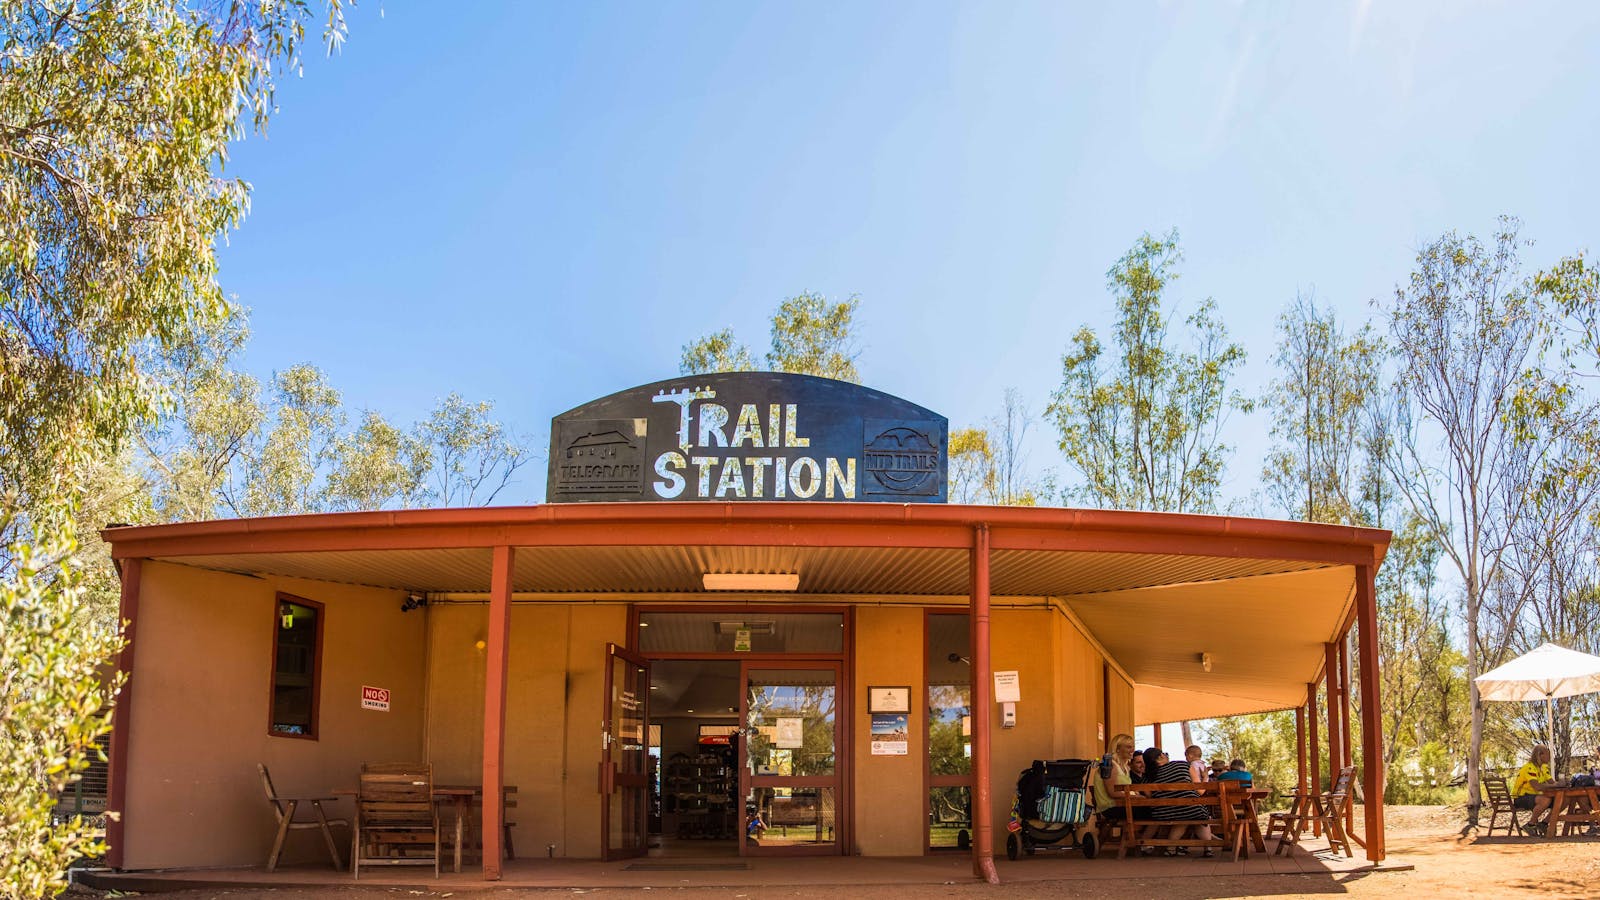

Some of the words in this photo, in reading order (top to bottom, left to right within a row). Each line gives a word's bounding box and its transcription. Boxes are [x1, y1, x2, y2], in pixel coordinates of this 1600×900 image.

[652, 385, 810, 454] TRAIL
[895, 454, 937, 469] TRAILS
[560, 464, 640, 479] TELEGRAPH
[652, 451, 857, 499] STATION
[365, 690, 377, 699] NO
